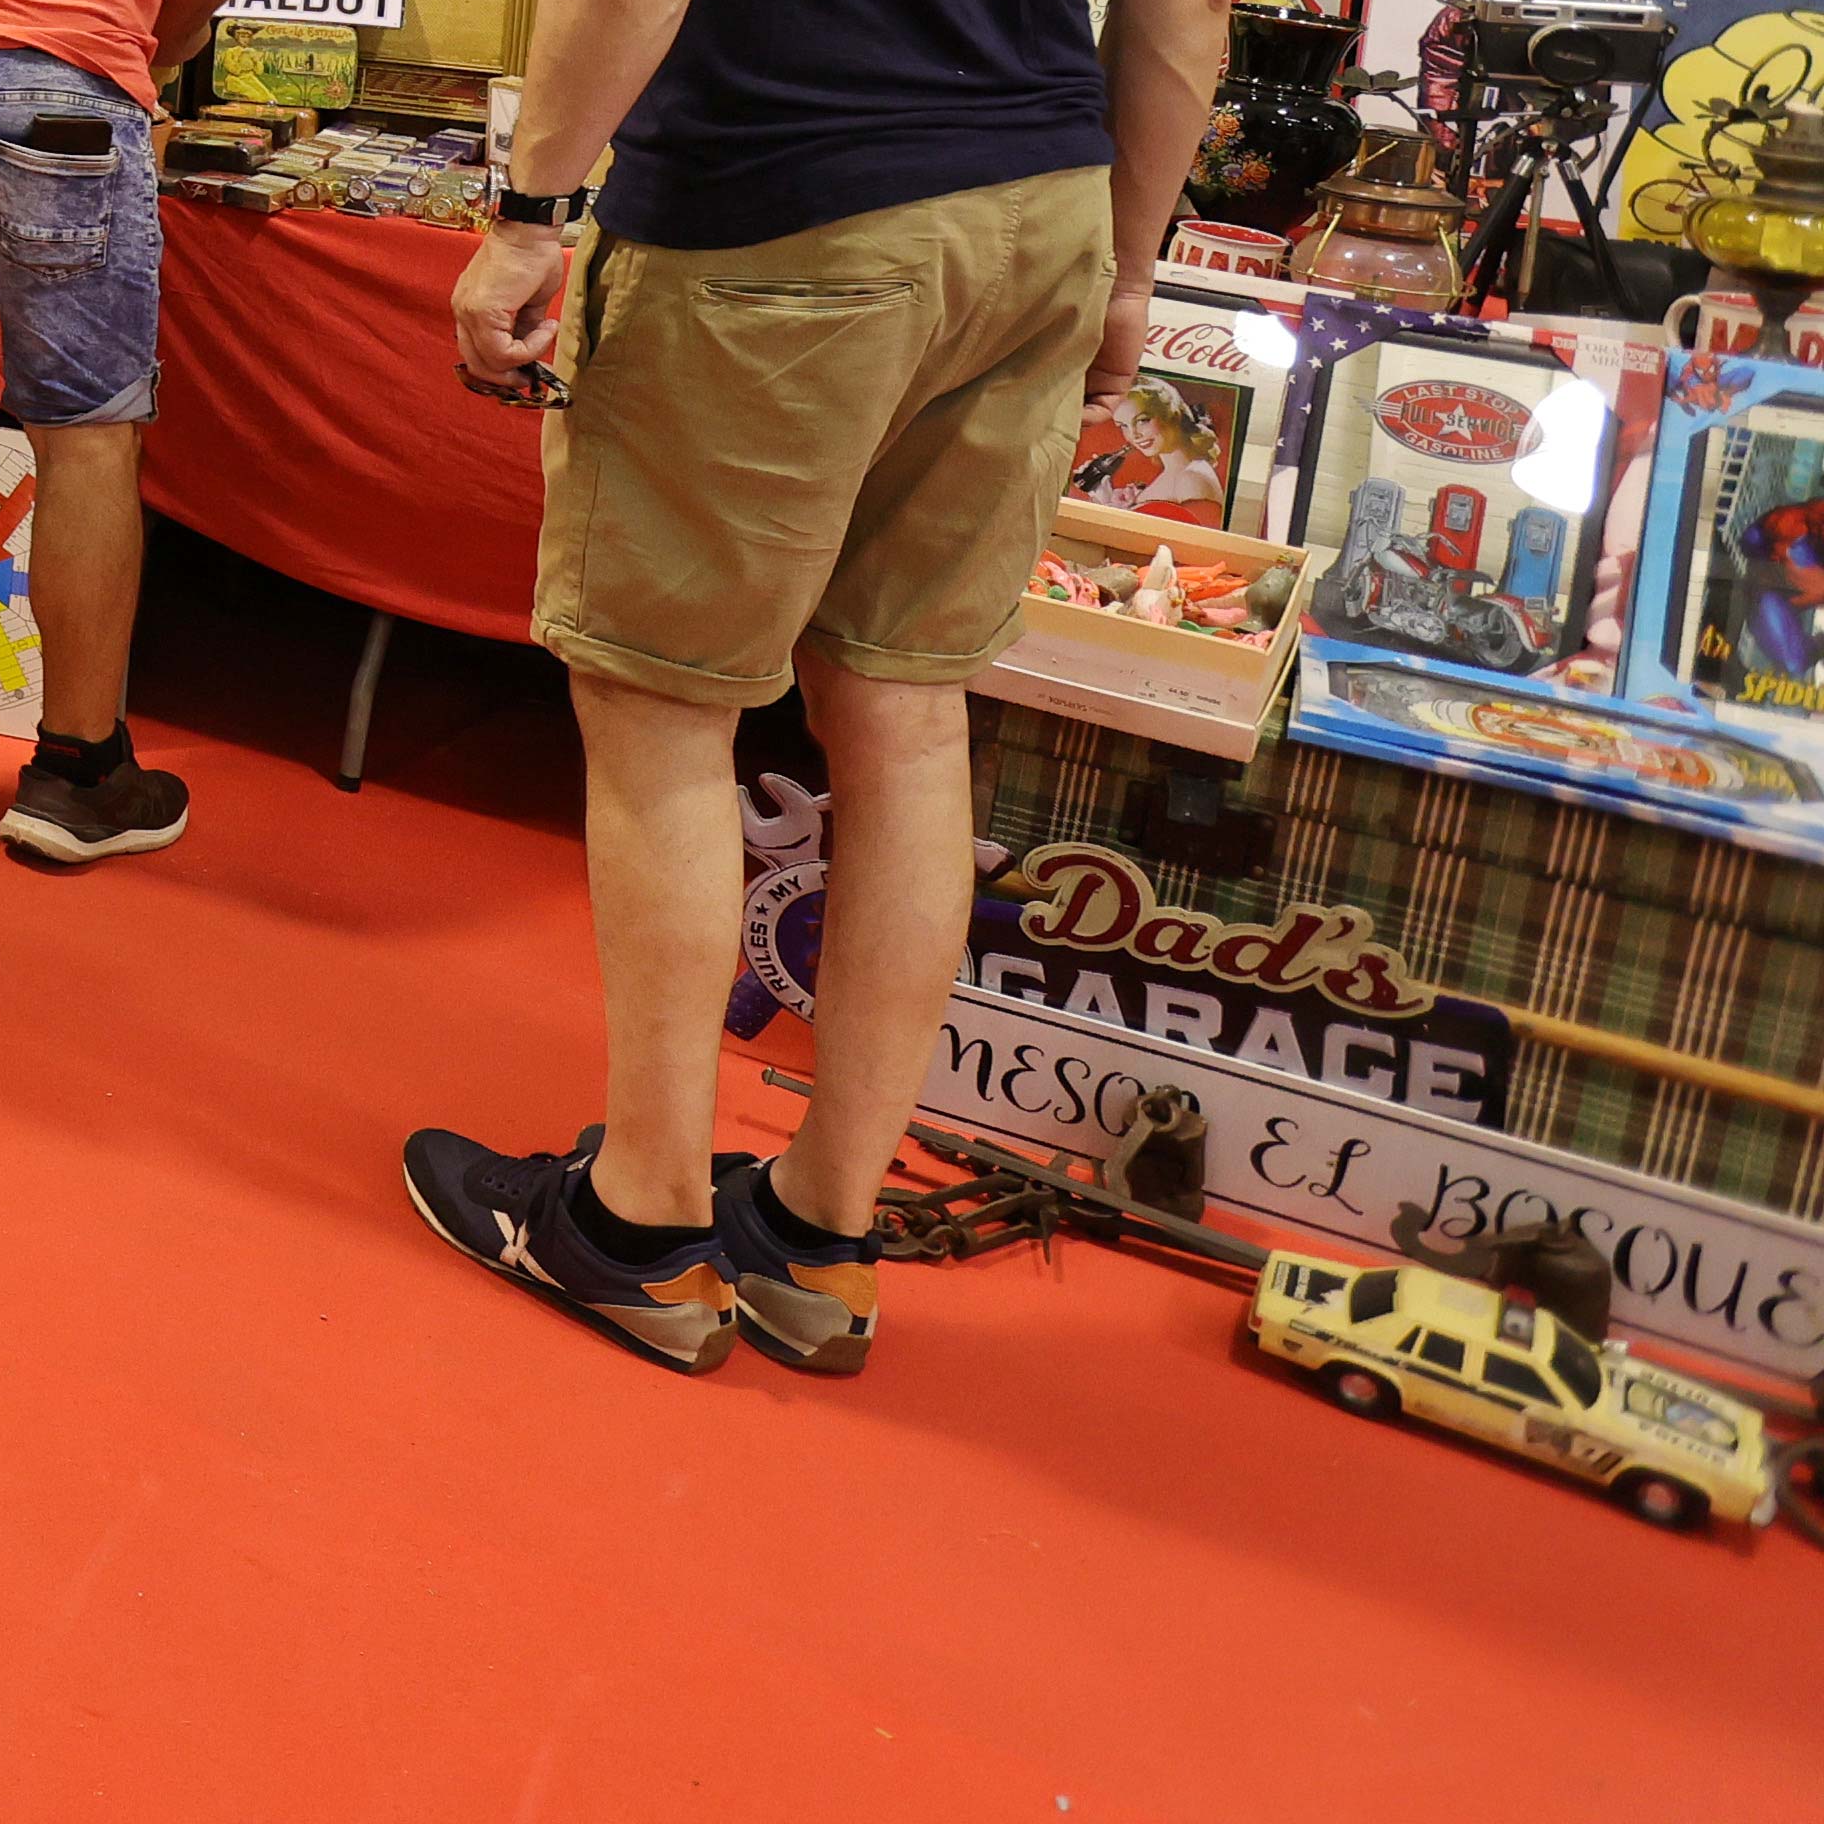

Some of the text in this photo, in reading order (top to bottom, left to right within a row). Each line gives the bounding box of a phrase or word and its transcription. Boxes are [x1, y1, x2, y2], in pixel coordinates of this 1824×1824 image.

[1403, 384, 1520, 416] LAST STOP
[1404, 430, 1504, 461] GASOLINE
[768, 875, 804, 905] MY
[750, 920, 789, 993] RULES
[1028, 853, 1425, 1013] Dad's
[981, 952, 1486, 1124] GARAGE
[1249, 1116, 1375, 1216] EL
